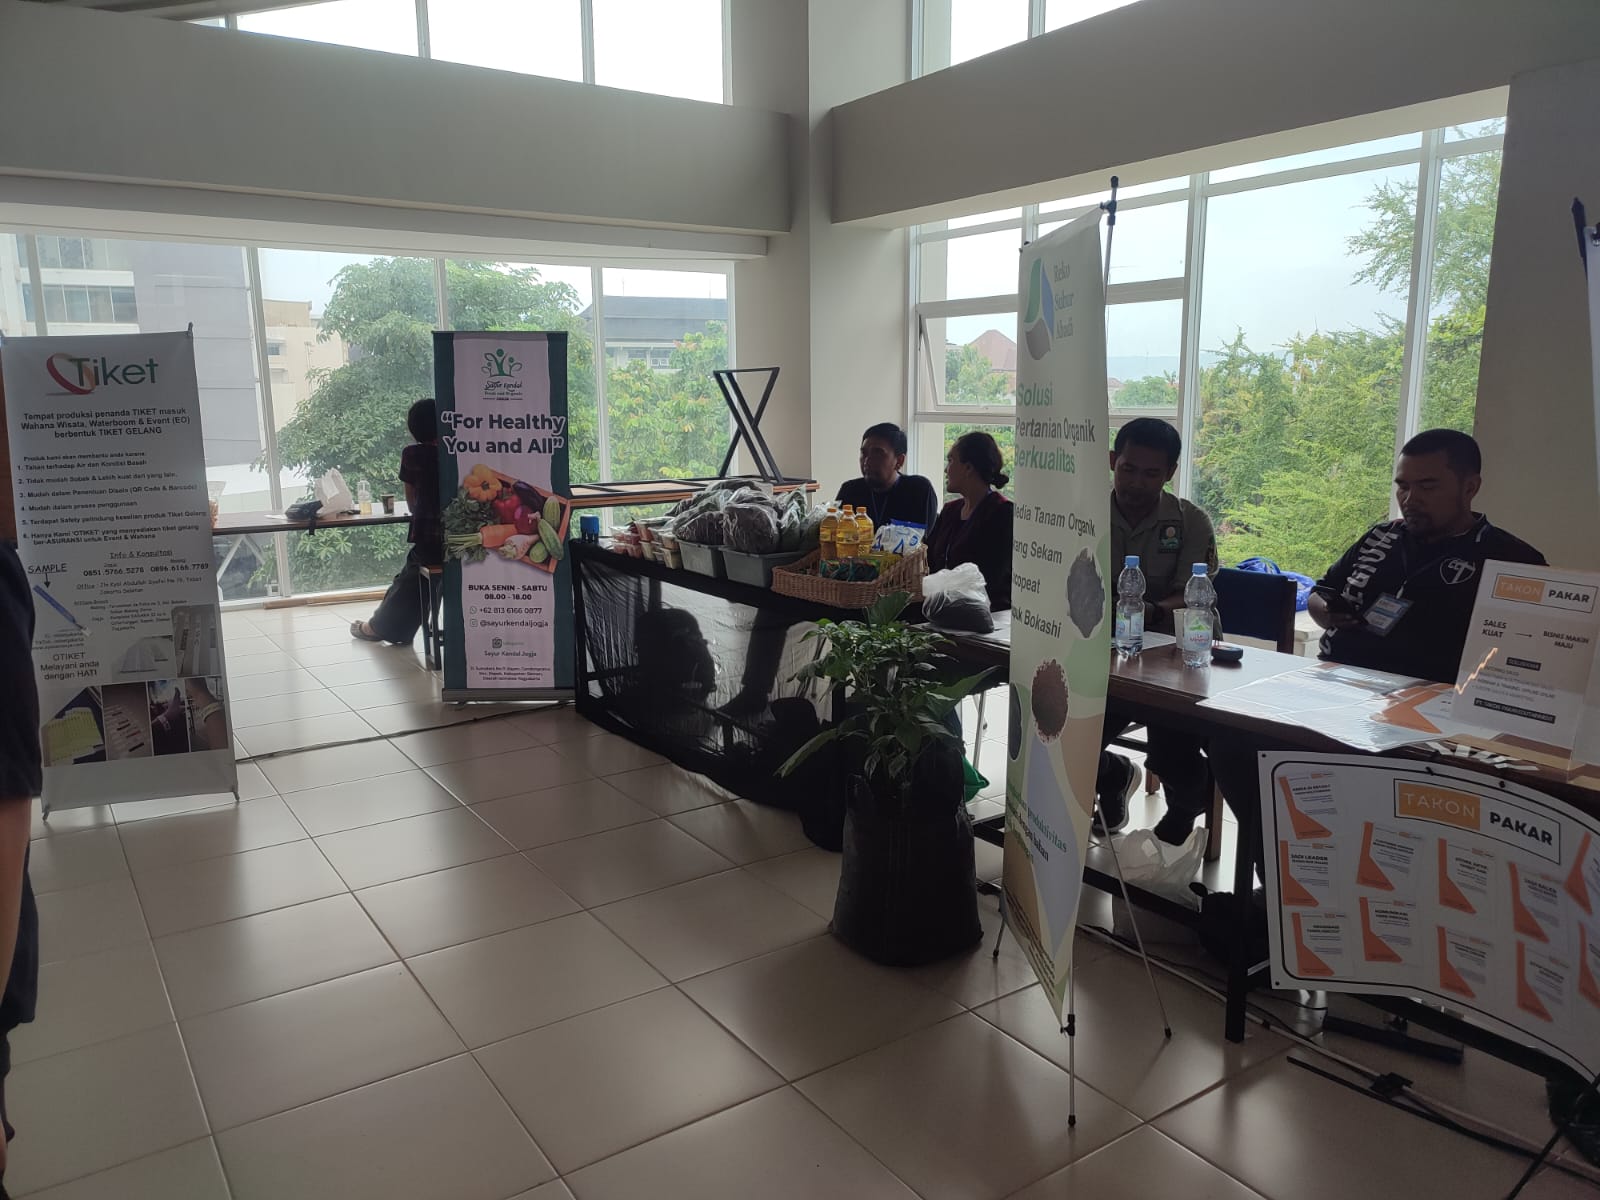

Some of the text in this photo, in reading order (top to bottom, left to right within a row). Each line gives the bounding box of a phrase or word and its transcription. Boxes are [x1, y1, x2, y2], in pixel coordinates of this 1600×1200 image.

[1017, 382, 1053, 408] Solusi
[24, 407, 186, 421] Tempat produksi penanda TIKET masuk
[20, 421, 55, 430] Wahana
[88, 418, 136, 428] Waterboom
[146, 416, 170, 425] Event
[489, 414, 565, 434] Healthy
[54, 426, 162, 439] berbentuk TIKET GELANG
[1015, 416, 1096, 447] Pertanian Organik
[444, 438, 480, 453] You
[486, 438, 522, 453] and
[1034, 506, 1065, 528] Tanam
[1068, 513, 1096, 537] Organik
[1013, 539, 1062, 565] rang Sekam
[27, 563, 68, 573] SAMPLE
[1012, 569, 1041, 595] copeat
[1501, 582, 1590, 603] TAKON PAKAR
[1024, 608, 1062, 639] Bokashi
[1483, 619, 1508, 629] SALES
[1481, 628, 1504, 638] KUAT
[1543, 630, 1564, 640] BISNIS
[40, 663, 77, 672] Melayani
[77, 669, 97, 677] HATI
[1403, 792, 1553, 847] TAKON PAKAR
